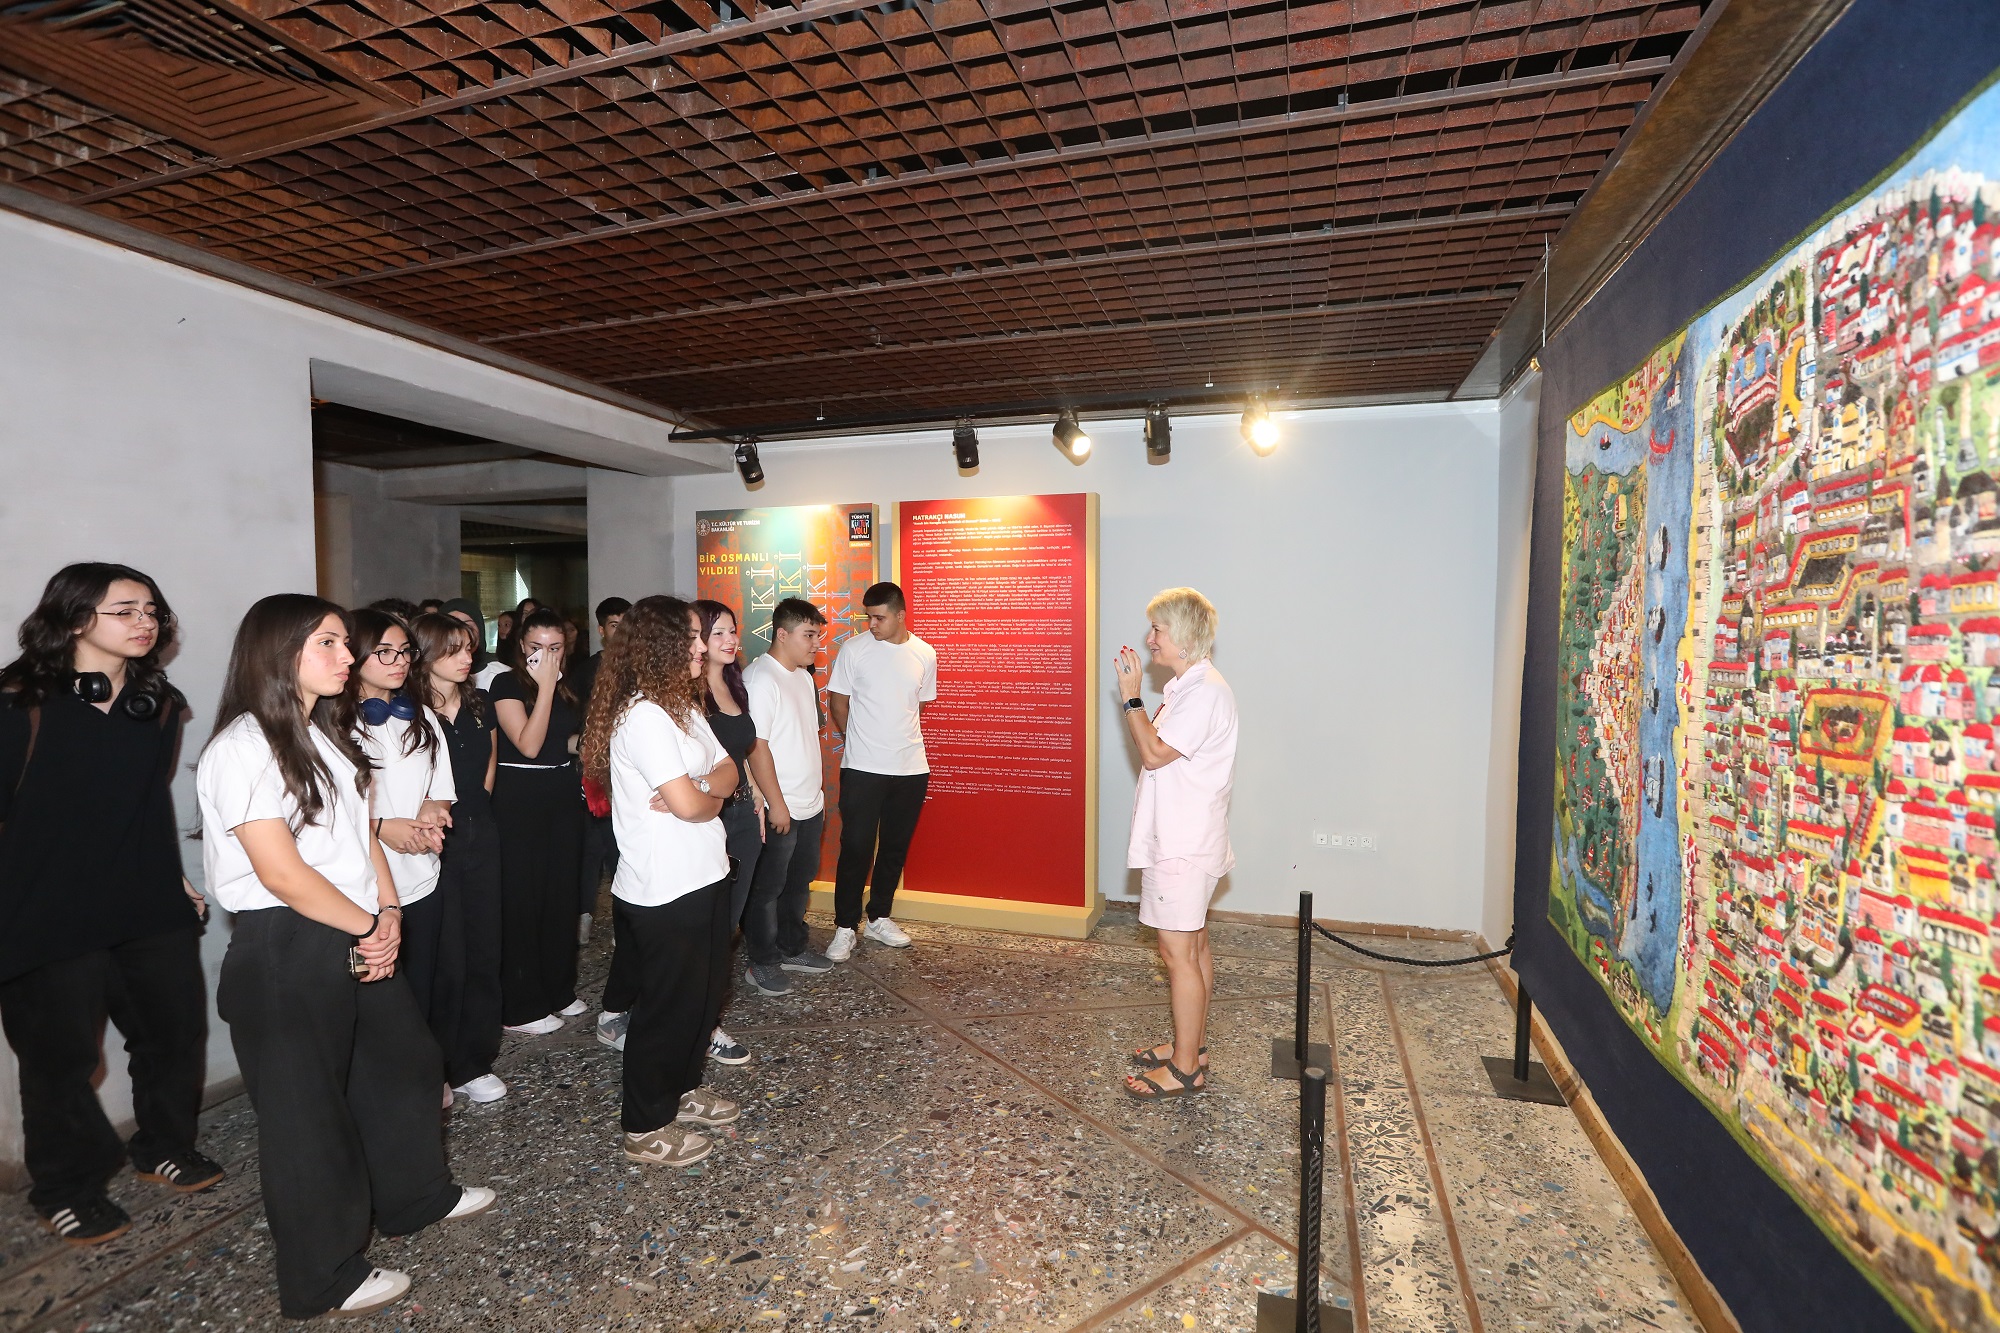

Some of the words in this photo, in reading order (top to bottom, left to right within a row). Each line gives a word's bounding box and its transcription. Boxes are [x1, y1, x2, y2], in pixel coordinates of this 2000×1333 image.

[699, 552, 717, 563] BİR
[720, 552, 769, 563] OSMANLI
[699, 566, 738, 576] YILDIZI
